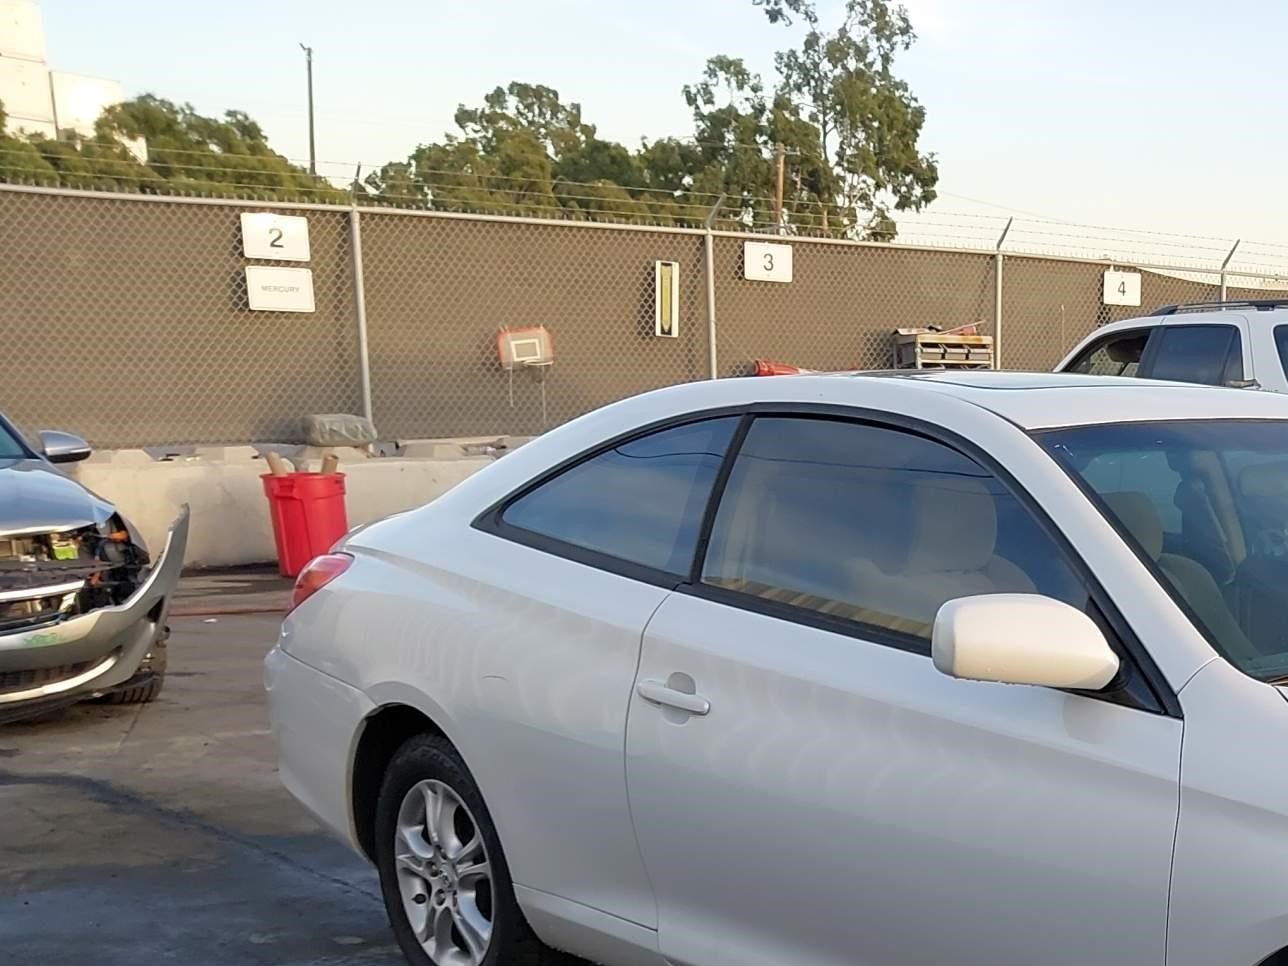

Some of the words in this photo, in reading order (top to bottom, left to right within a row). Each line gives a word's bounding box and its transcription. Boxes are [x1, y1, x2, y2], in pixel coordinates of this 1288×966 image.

[268, 228, 284, 248] 2
[763, 253, 774, 272] 3
[1117, 280, 1127, 297] 4
